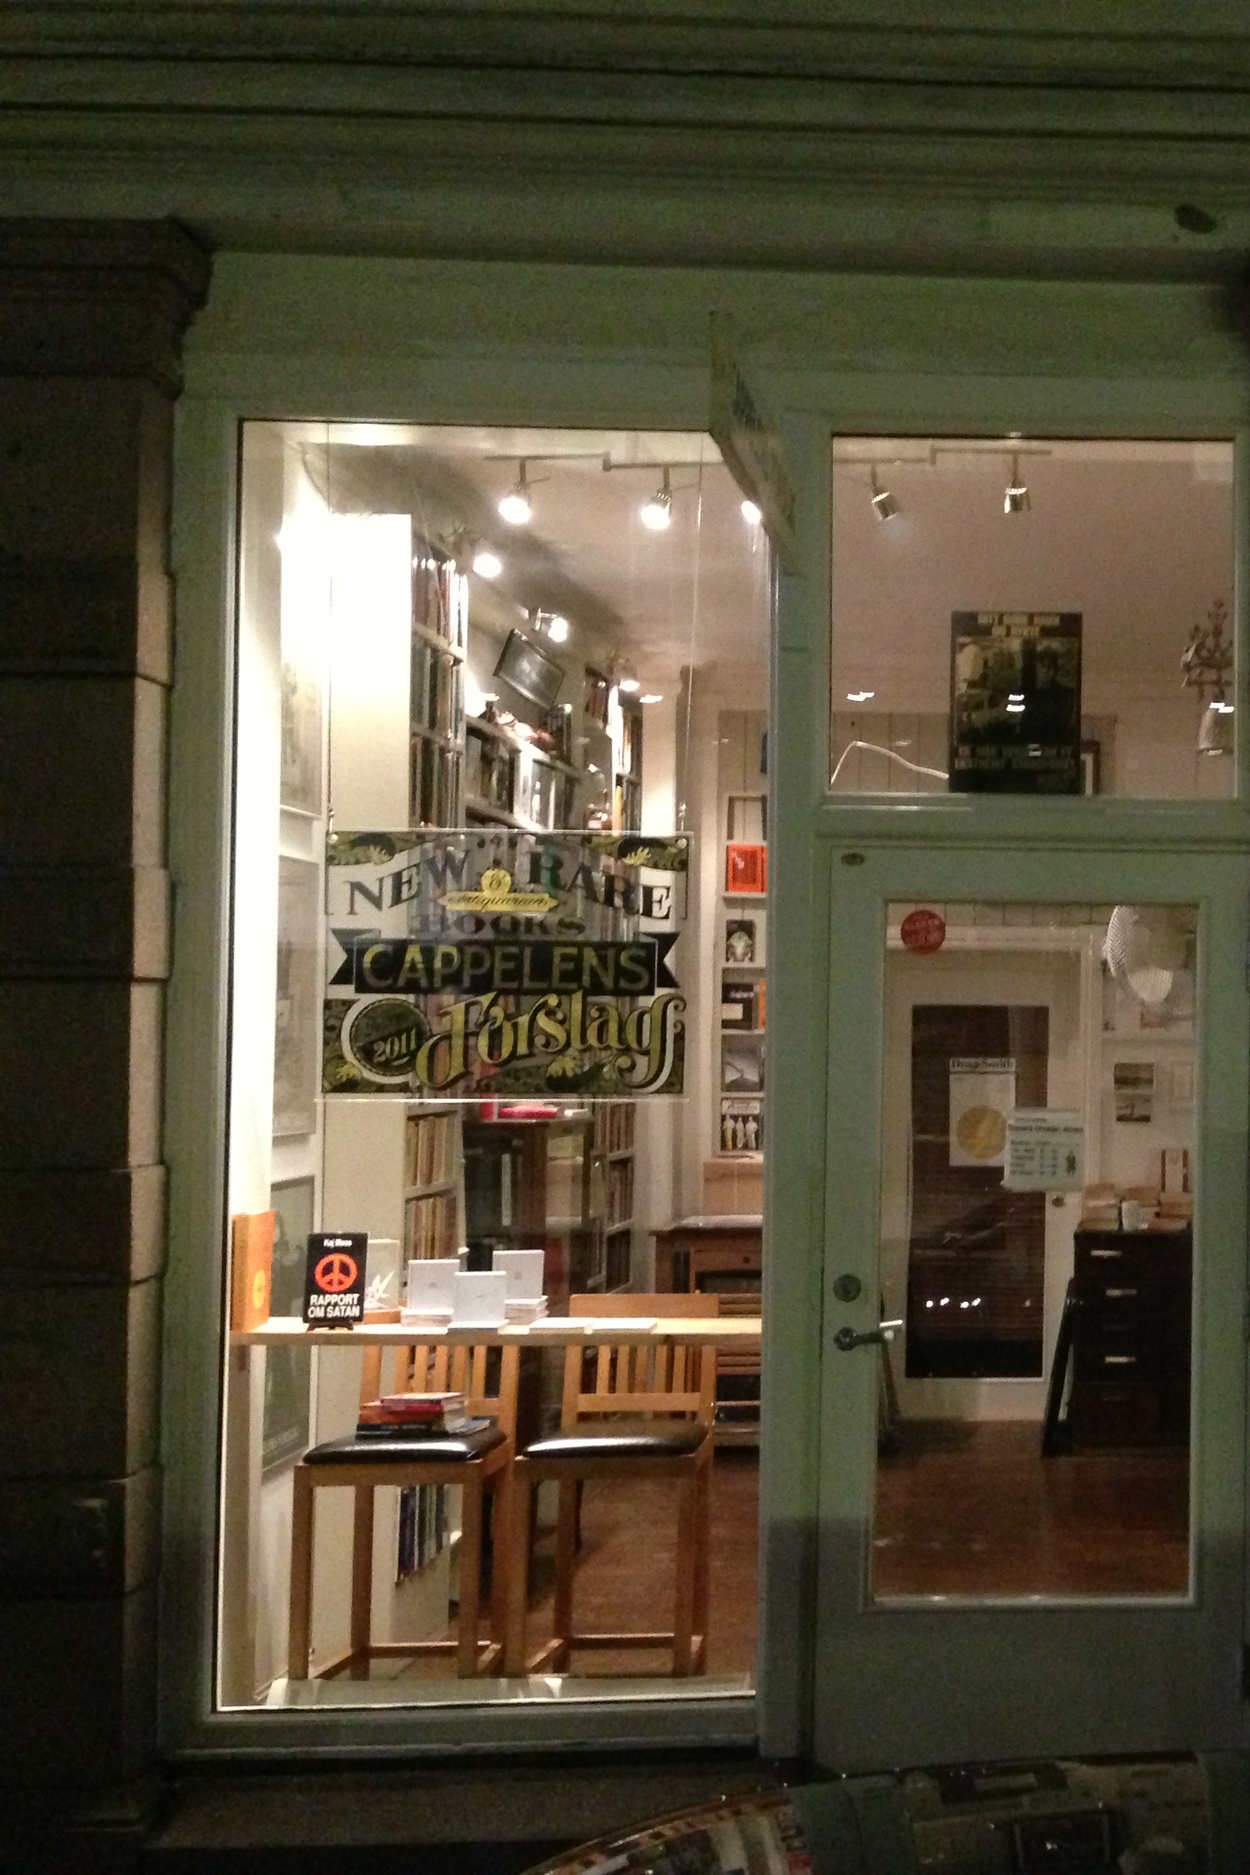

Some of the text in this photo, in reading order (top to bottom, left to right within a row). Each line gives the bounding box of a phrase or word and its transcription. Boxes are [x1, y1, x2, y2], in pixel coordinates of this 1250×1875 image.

[348, 846, 471, 916] NEW
[527, 848, 675, 918] RARE
[362, 944, 649, 990] CAPPELENS
[373, 1027, 417, 1063] 2011
[415, 990, 687, 1092] Forslag
[307, 1306, 360, 1317] OM SATAN
[310, 1294, 360, 1305] RAPPORT
